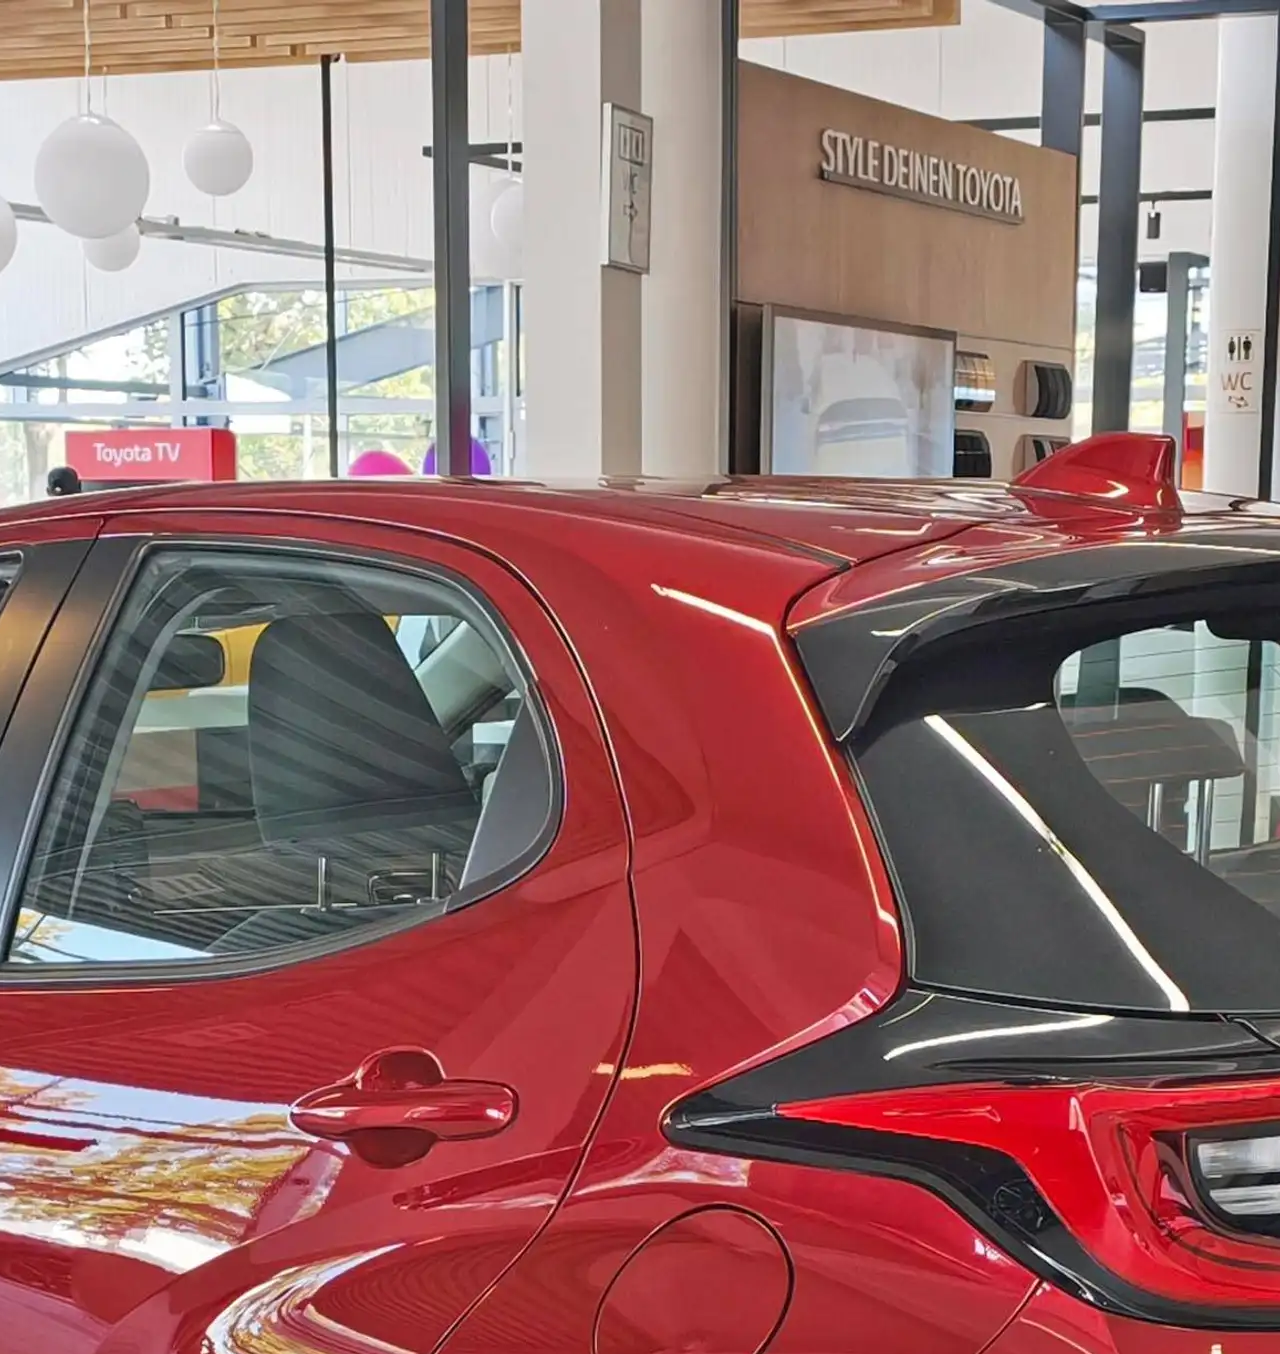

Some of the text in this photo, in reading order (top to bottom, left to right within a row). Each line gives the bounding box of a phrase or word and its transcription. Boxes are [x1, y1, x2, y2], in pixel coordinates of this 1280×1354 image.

[821, 128, 1023, 218] STYLE DEINEN TOYOTA
[1221, 371, 1253, 391] WC
[92, 442, 181, 467] Toyota TV
